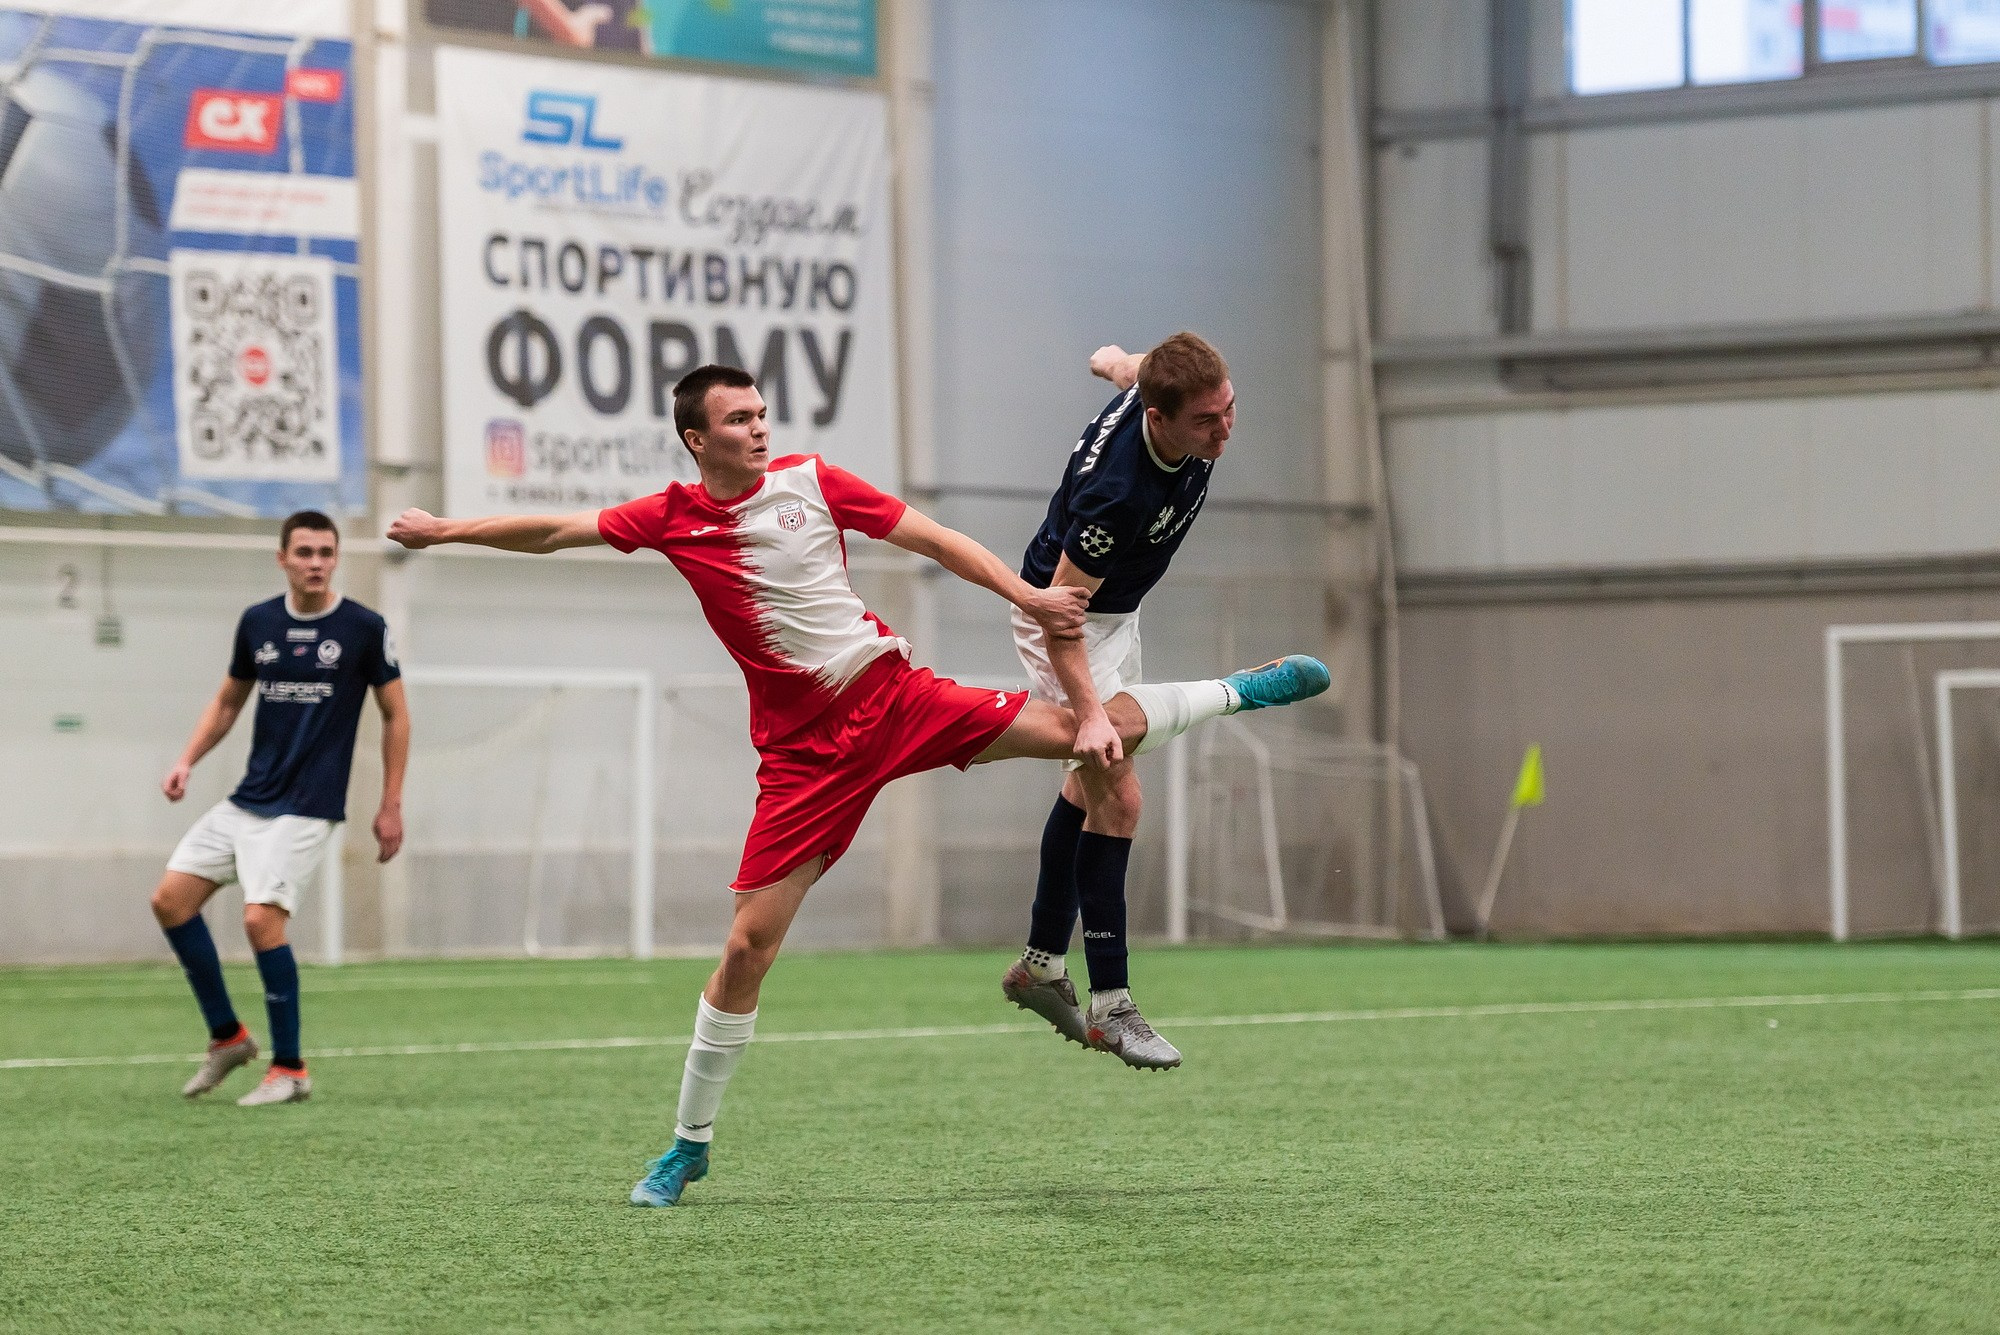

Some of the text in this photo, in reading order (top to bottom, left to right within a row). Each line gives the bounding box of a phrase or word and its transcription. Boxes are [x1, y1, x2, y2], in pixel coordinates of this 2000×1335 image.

[523, 90, 623, 150] SL
[479, 151, 669, 207] SportLife
[484, 233, 858, 313] СПОРТИВНУЮ
[486, 308, 855, 427] ФОРМУ
